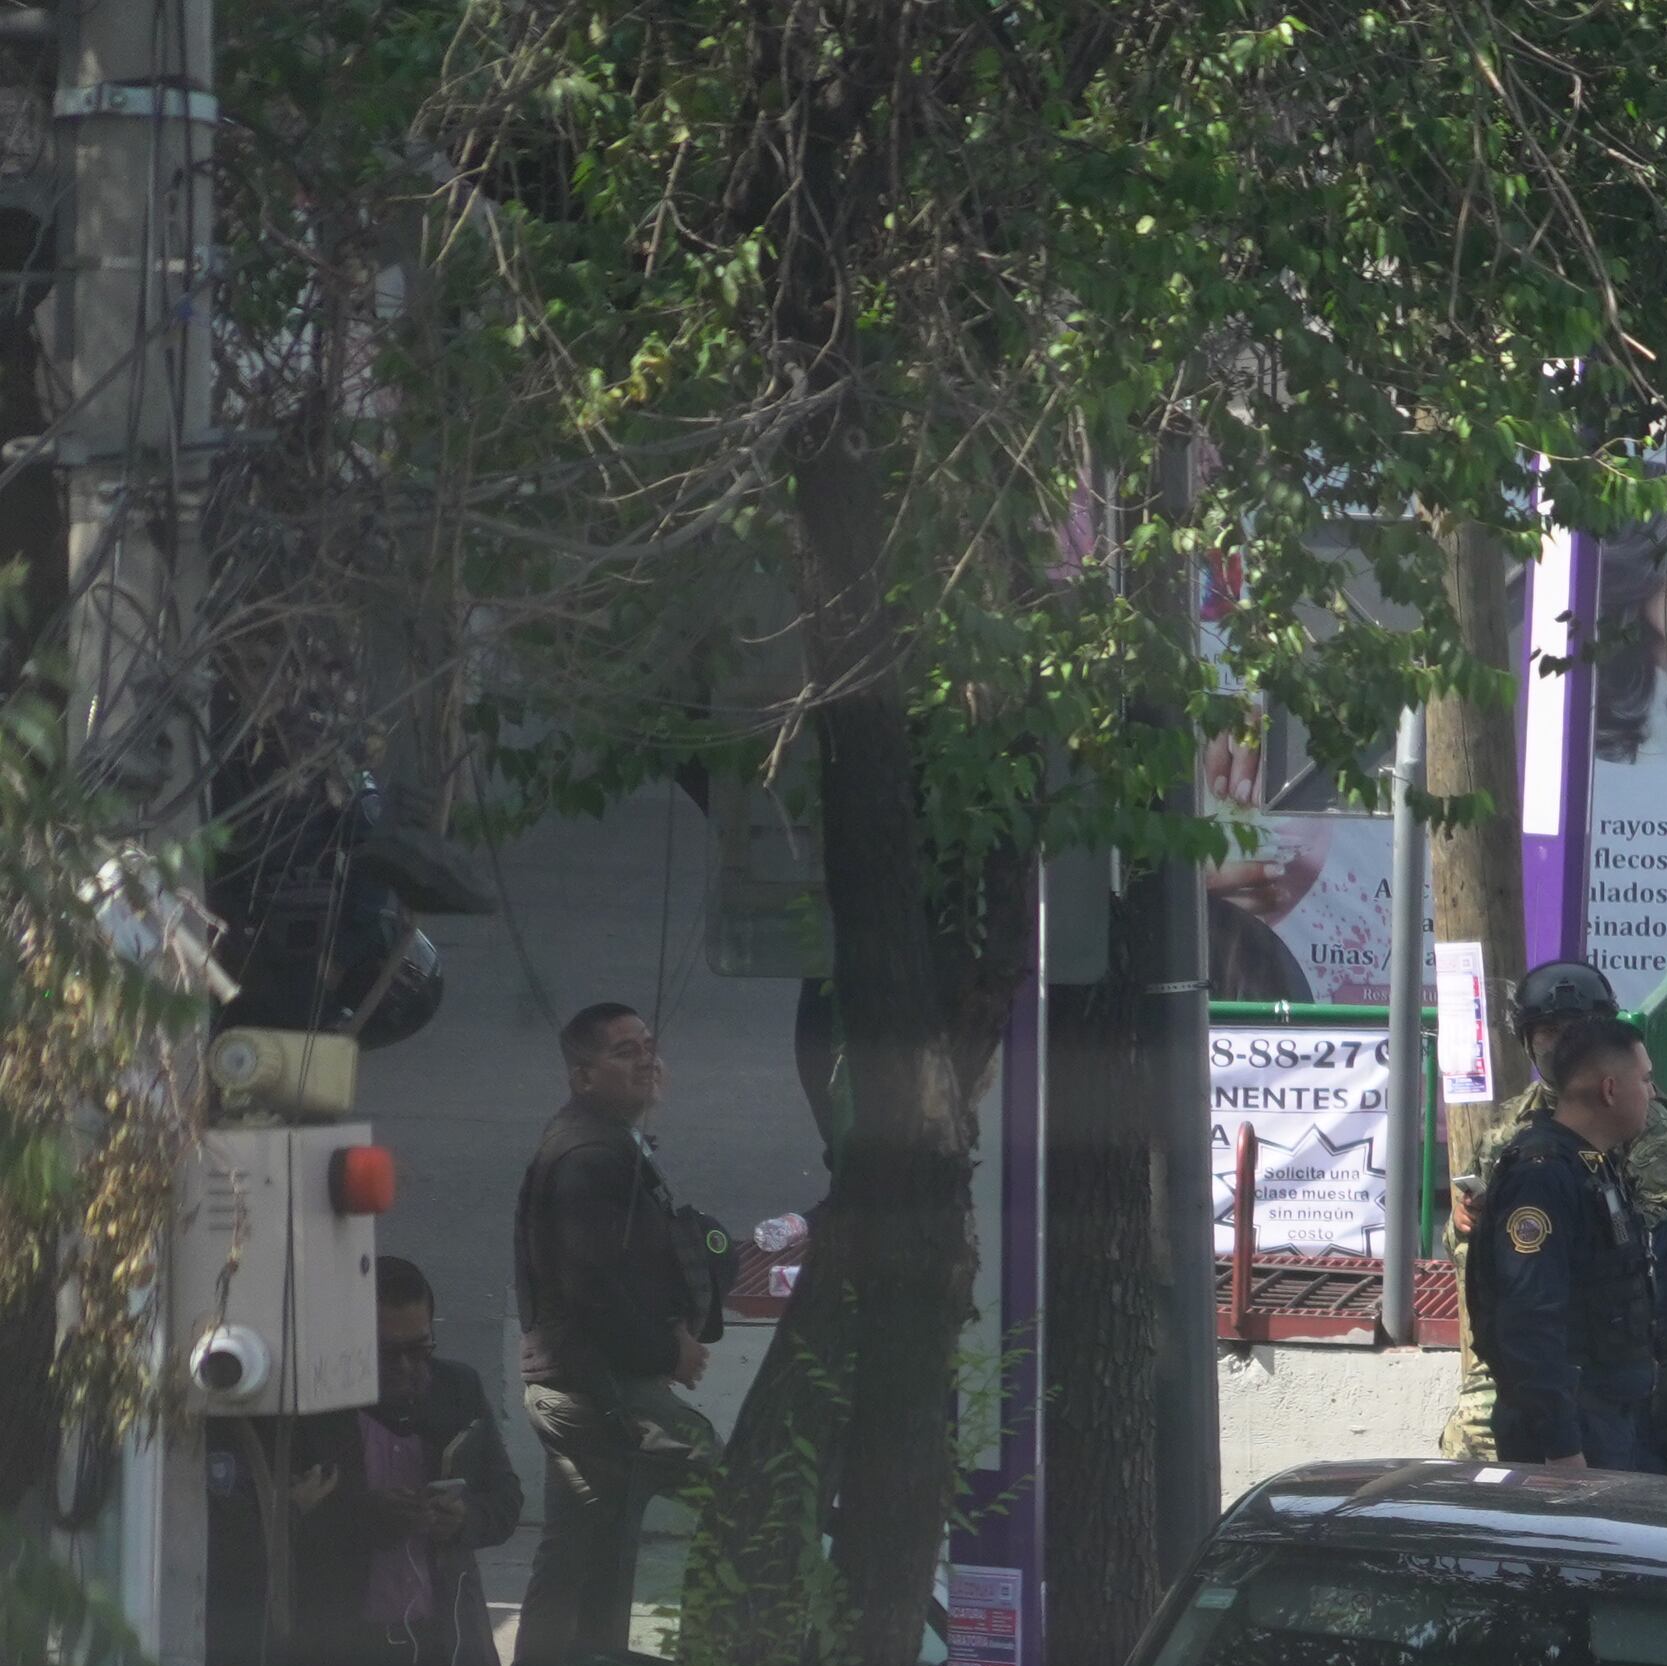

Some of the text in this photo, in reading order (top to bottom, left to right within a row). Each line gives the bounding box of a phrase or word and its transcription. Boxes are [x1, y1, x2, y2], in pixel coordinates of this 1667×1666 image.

[1600, 818, 1667, 841] rayos
[1595, 848, 1667, 870] flecos
[1311, 944, 1373, 965] Uñas
[1211, 1039, 1362, 1069] 8-88-27
[1211, 1086, 1389, 1111] NENTES D
[1264, 1166, 1360, 1181] Solicita una
[1254, 1187, 1369, 1201] clase muestra
[1268, 1206, 1354, 1222] sin ningún
[1287, 1227, 1334, 1240] costo
